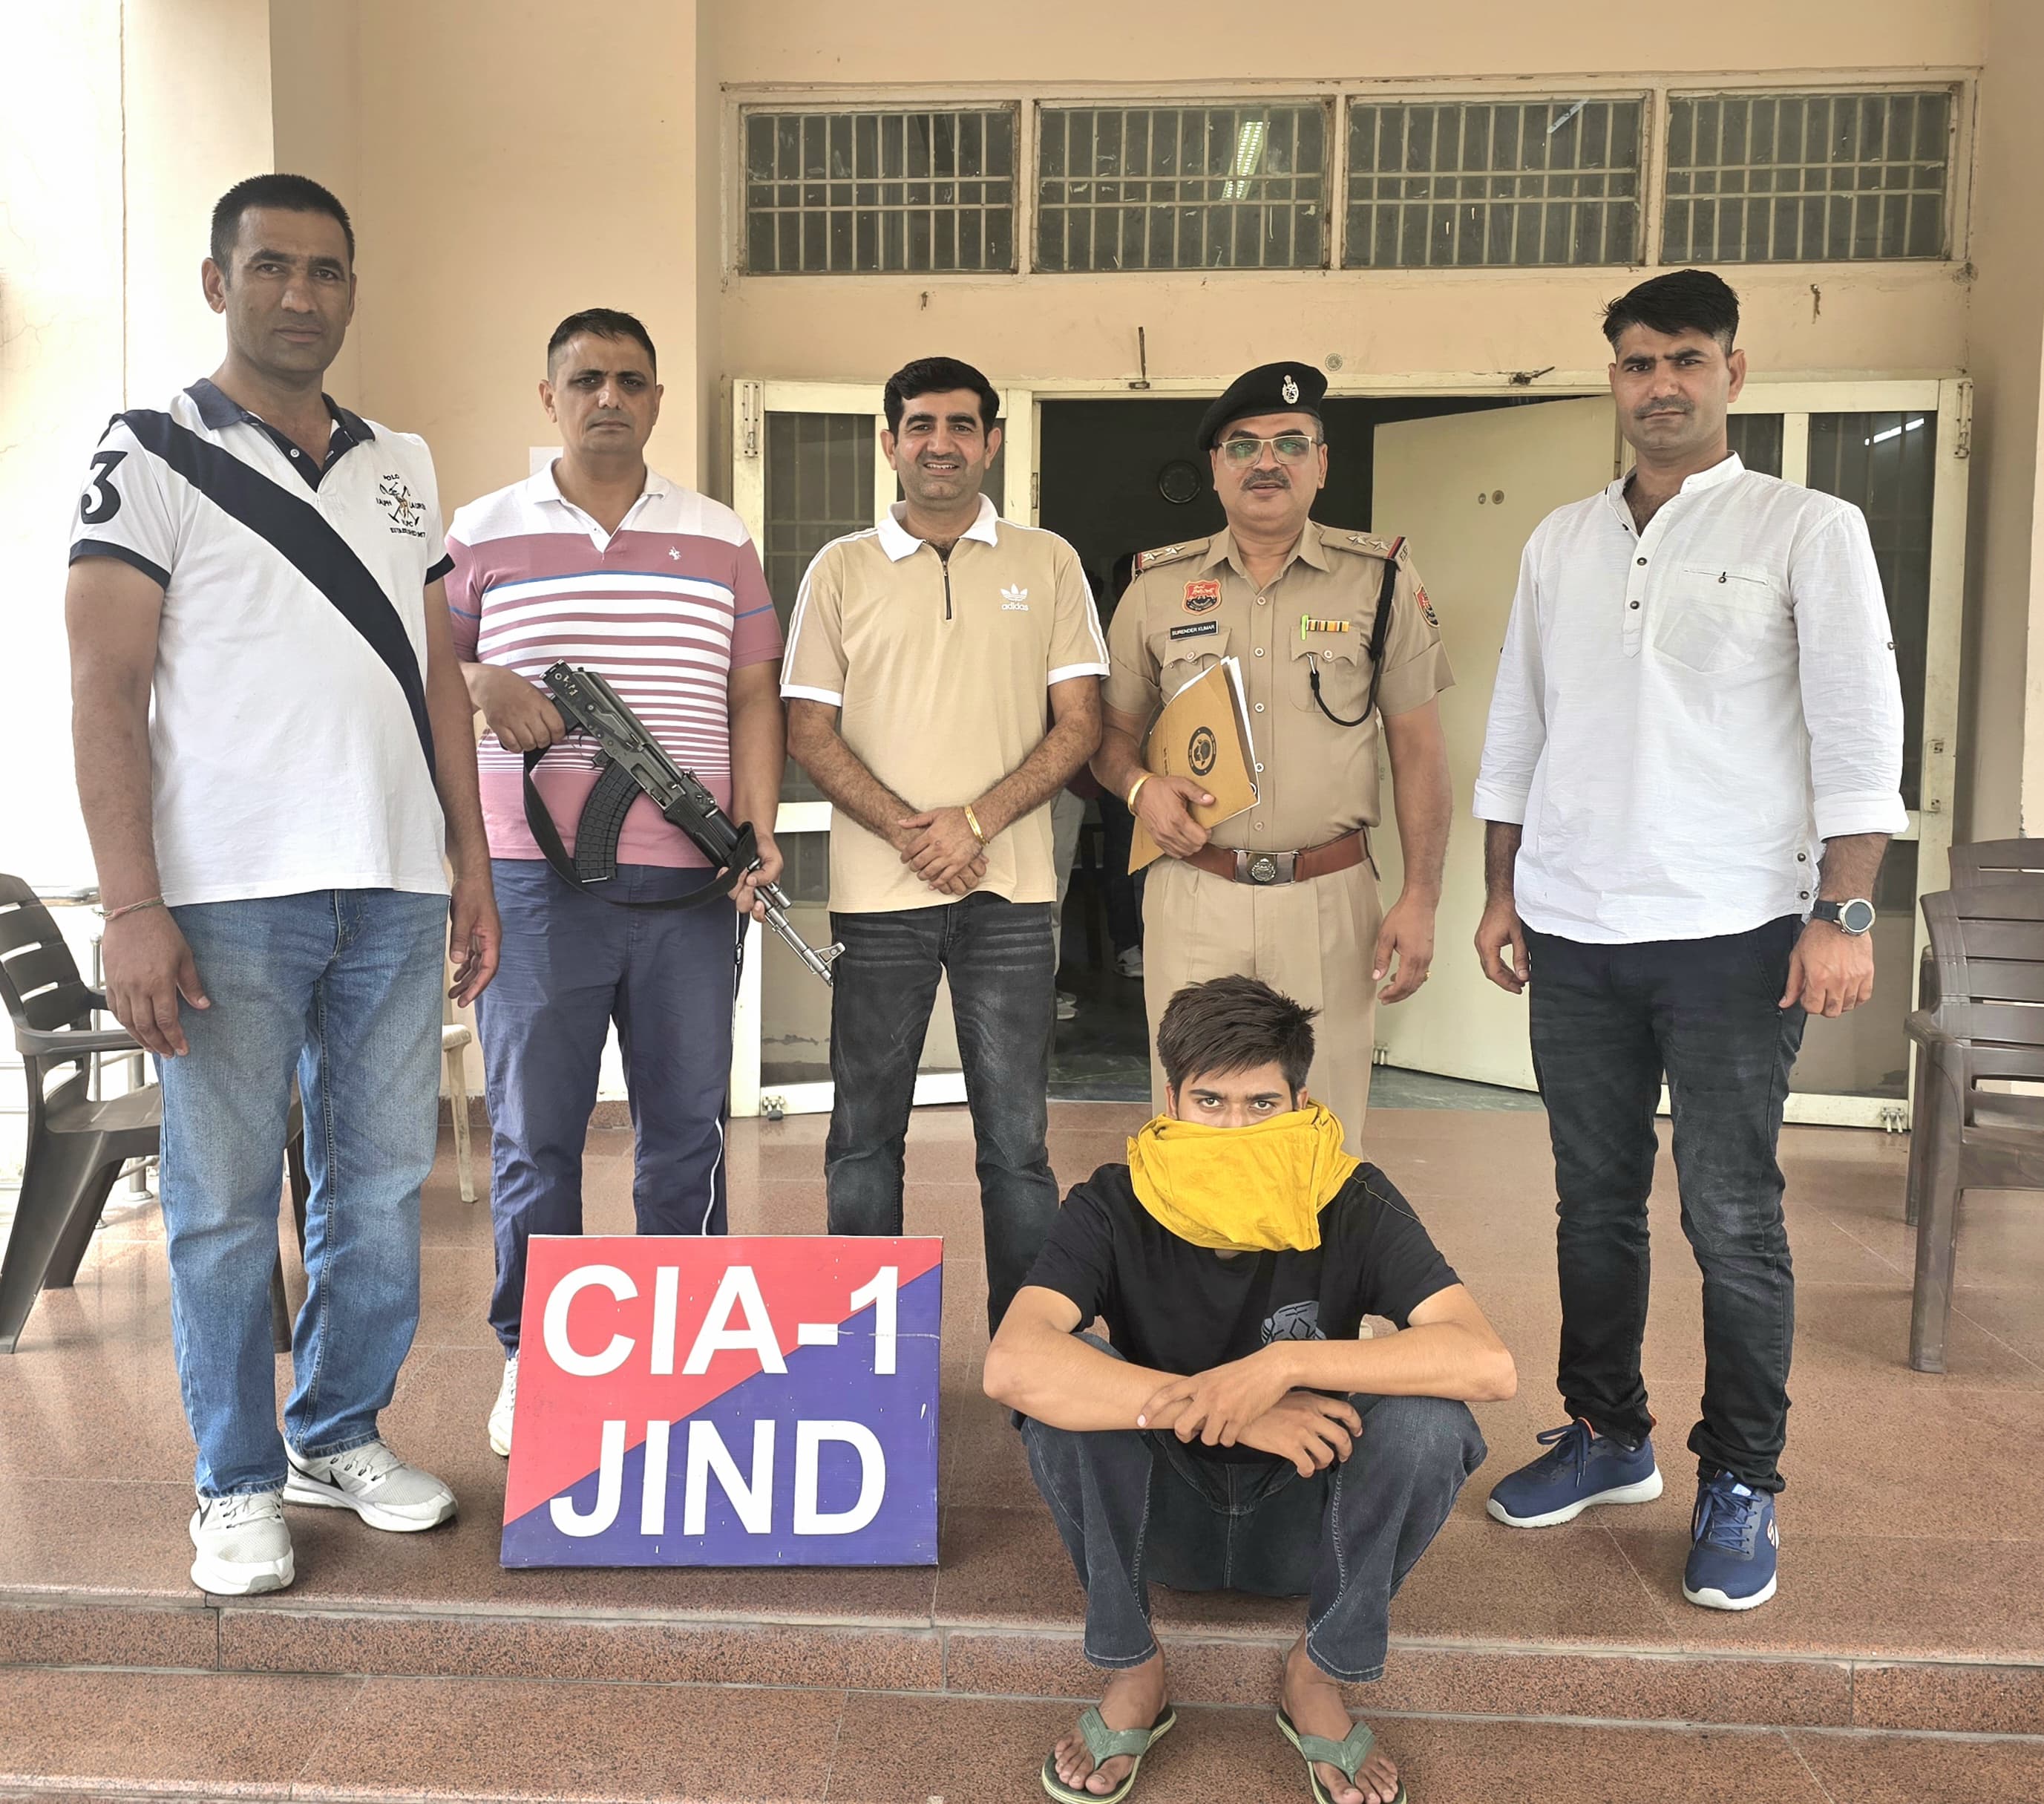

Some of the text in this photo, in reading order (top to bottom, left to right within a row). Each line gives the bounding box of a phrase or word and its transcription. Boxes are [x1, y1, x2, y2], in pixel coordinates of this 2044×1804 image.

[81, 451, 128, 524] 3
[1001, 602, 1029, 611] adidas
[1172, 627, 1198, 636] SURENDER
[543, 1264, 899, 1376] CIA-1
[549, 1419, 886, 1537] JIND
